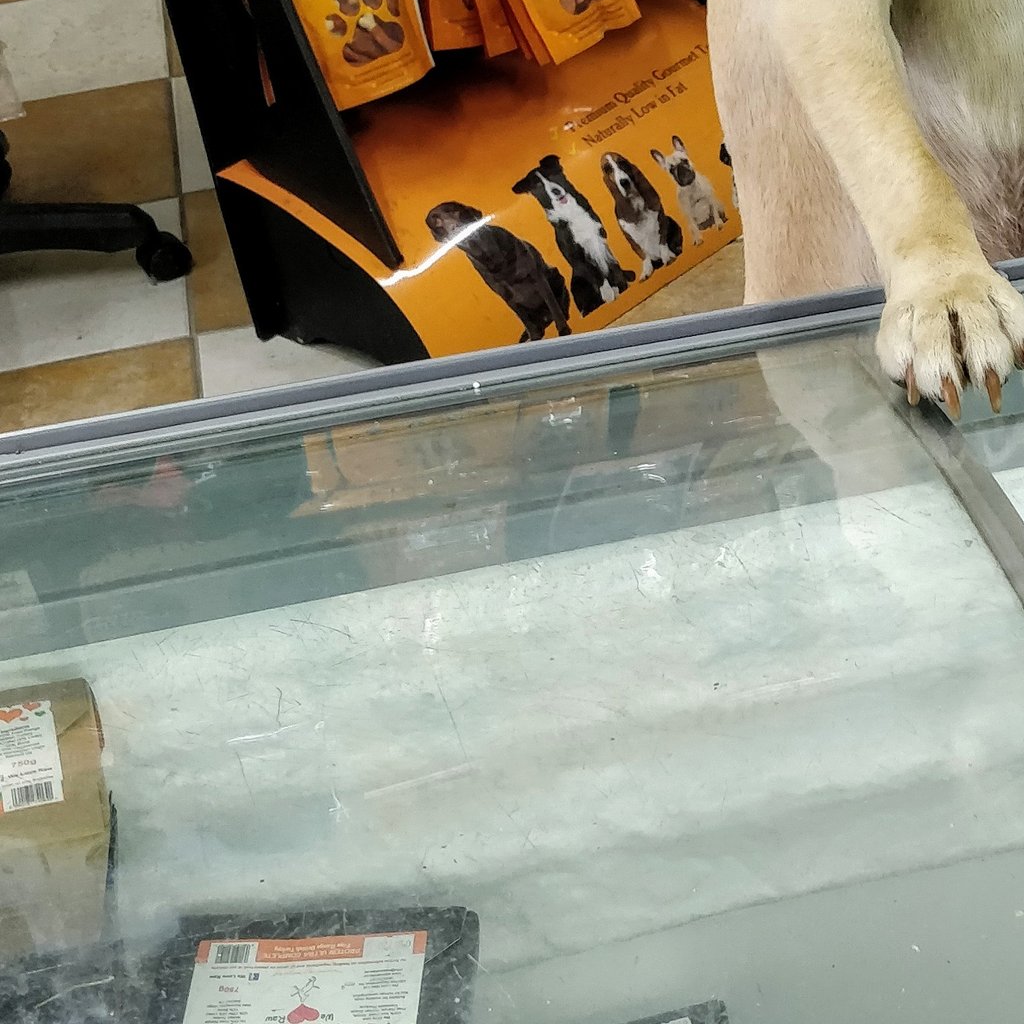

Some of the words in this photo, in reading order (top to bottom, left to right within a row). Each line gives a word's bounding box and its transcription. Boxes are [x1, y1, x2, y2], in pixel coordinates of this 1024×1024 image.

[563, 99, 618, 133] Premium
[612, 75, 658, 106] Quality
[651, 50, 698, 81] Gourmet
[581, 113, 636, 148] Naturally
[630, 100, 658, 120] Low
[658, 93, 668, 105] in
[666, 81, 689, 99] Fat
[11, 758, 37, 769] 750g
[219, 985, 239, 993] 750g
[264, 1015, 286, 1023] Raw
